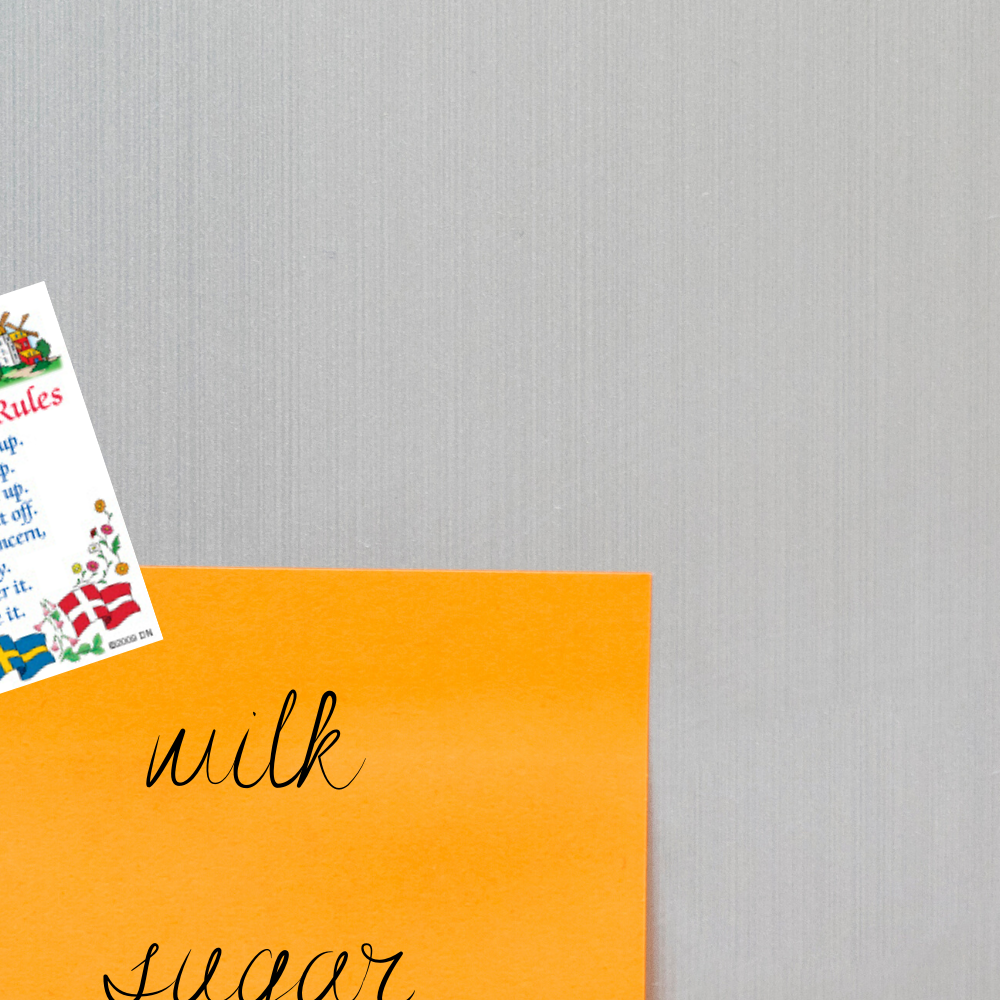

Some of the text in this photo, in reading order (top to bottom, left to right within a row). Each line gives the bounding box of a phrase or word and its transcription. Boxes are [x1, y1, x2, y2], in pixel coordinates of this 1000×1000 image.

[2, 483, 29, 503] up.
[11, 499, 38, 526] off.
[12, 579, 33, 595] it.
[5, 606, 26, 622] it.
[145, 688, 366, 791] milk
